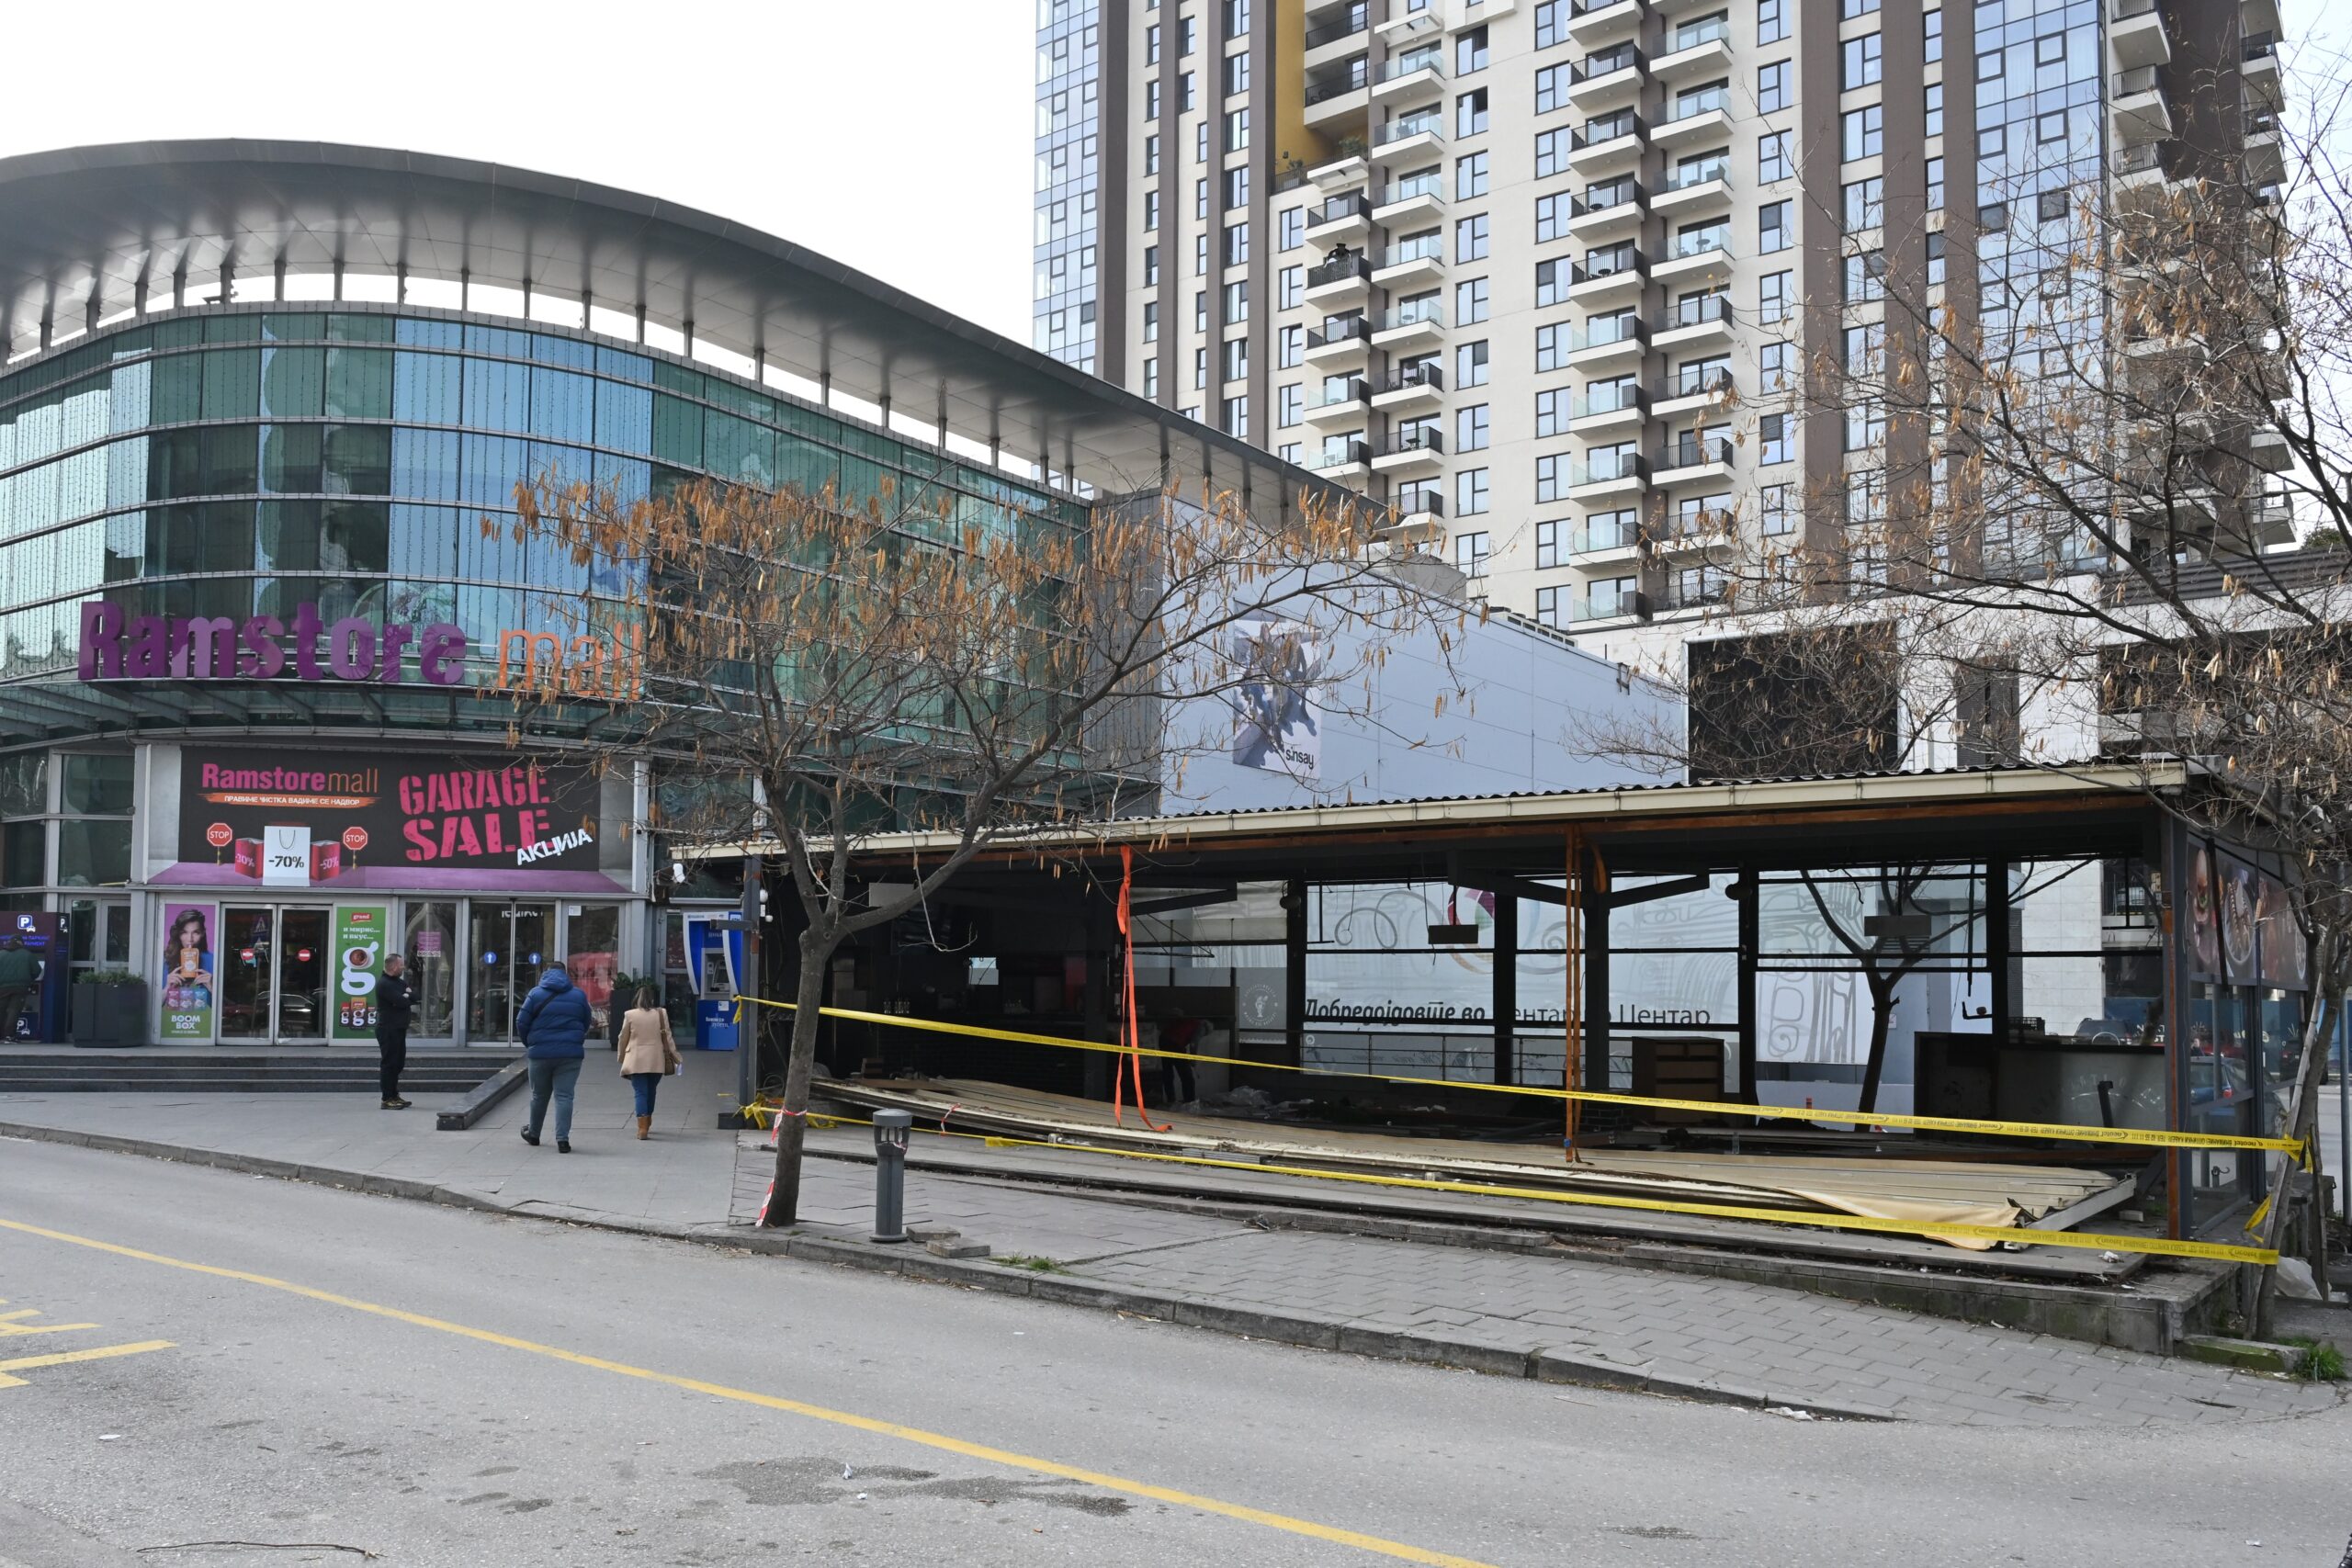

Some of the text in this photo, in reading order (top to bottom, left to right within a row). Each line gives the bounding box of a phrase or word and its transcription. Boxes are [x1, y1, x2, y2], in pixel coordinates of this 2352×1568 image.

[78, 601, 641, 701] Ramstore mall
[1286, 747, 1314, 770] sinsay
[399, 764, 550, 815] GARAGE
[209, 830, 230, 839] STOP
[346, 834, 365, 842] STOP
[402, 809, 554, 861] SALE
[517, 828, 593, 865] АКЦИЈА
[235, 853, 254, 867] -30%
[268, 855, 304, 868] -70%
[320, 856, 339, 870] -50%
[20, 917, 29, 927] P
